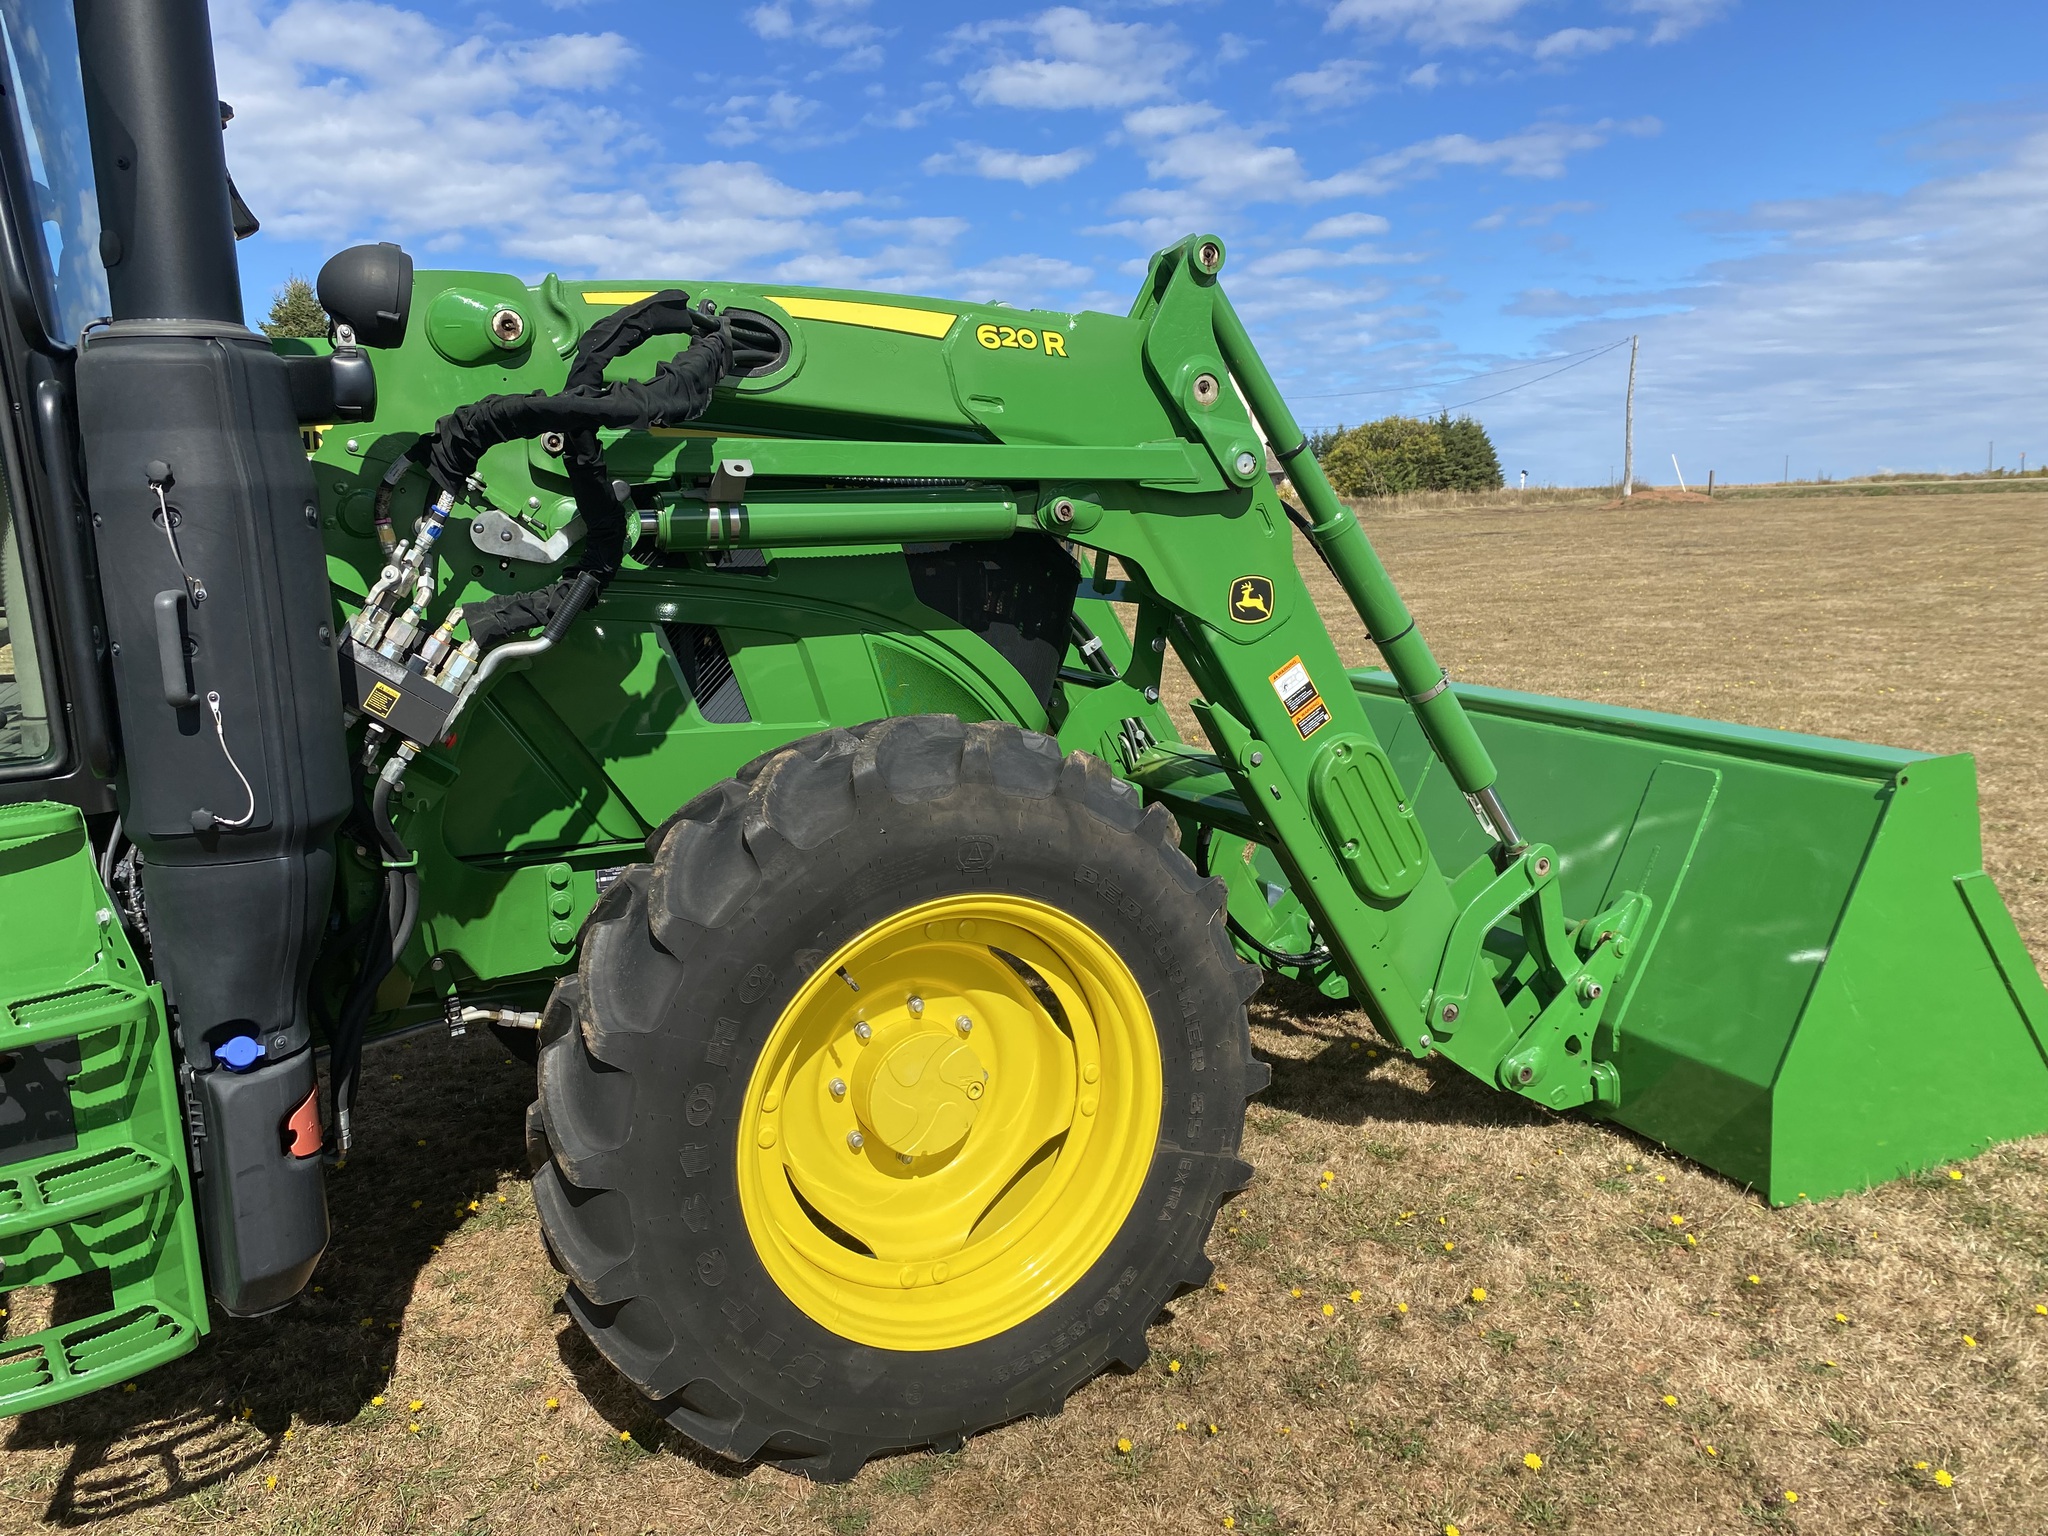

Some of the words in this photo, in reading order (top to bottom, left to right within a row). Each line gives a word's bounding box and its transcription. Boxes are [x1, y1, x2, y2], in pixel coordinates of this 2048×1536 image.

[976, 323, 1038, 351] 620
[1041, 330, 1069, 358] R
[1276, 659, 1297, 677] WARNING
[1301, 700, 1320, 716] WARNING
[1073, 863, 1206, 1072] PERFORMER
[1186, 1091, 1205, 1139] 85
[1156, 1157, 1193, 1222] EXTRA
[991, 1265, 1138, 1385] 340/85R28
